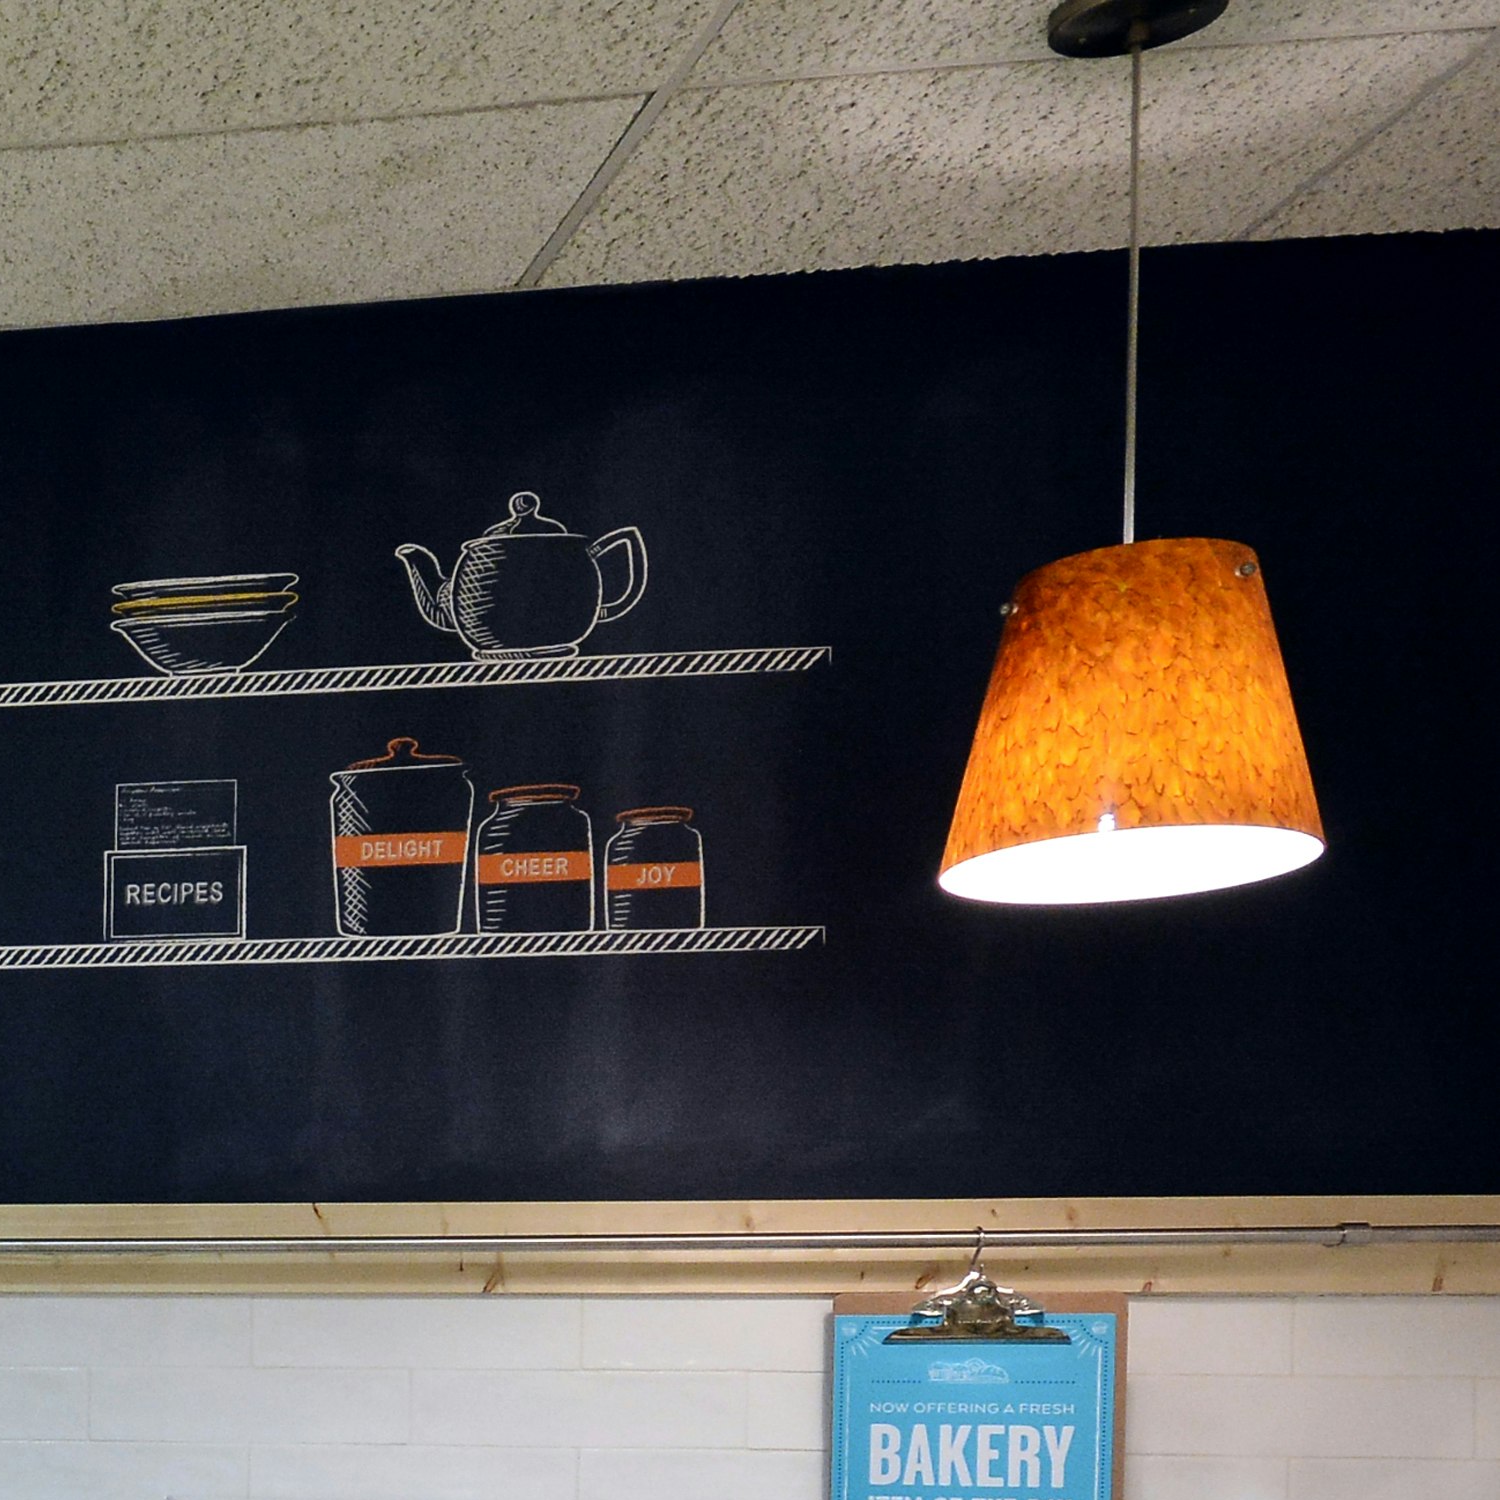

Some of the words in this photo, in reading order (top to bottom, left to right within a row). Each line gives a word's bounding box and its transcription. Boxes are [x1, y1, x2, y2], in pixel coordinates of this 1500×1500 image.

[361, 839, 444, 861] DELIGHT
[501, 857, 569, 877] CHEER
[636, 866, 676, 885] JOY
[125, 881, 224, 905] RECIPES
[870, 1402, 909, 1414] NOW
[913, 1402, 999, 1414] OFFERING
[1003, 1403, 1014, 1414] A
[1019, 1403, 1075, 1415] FRESH
[868, 1423, 1075, 1489] BAKERY
